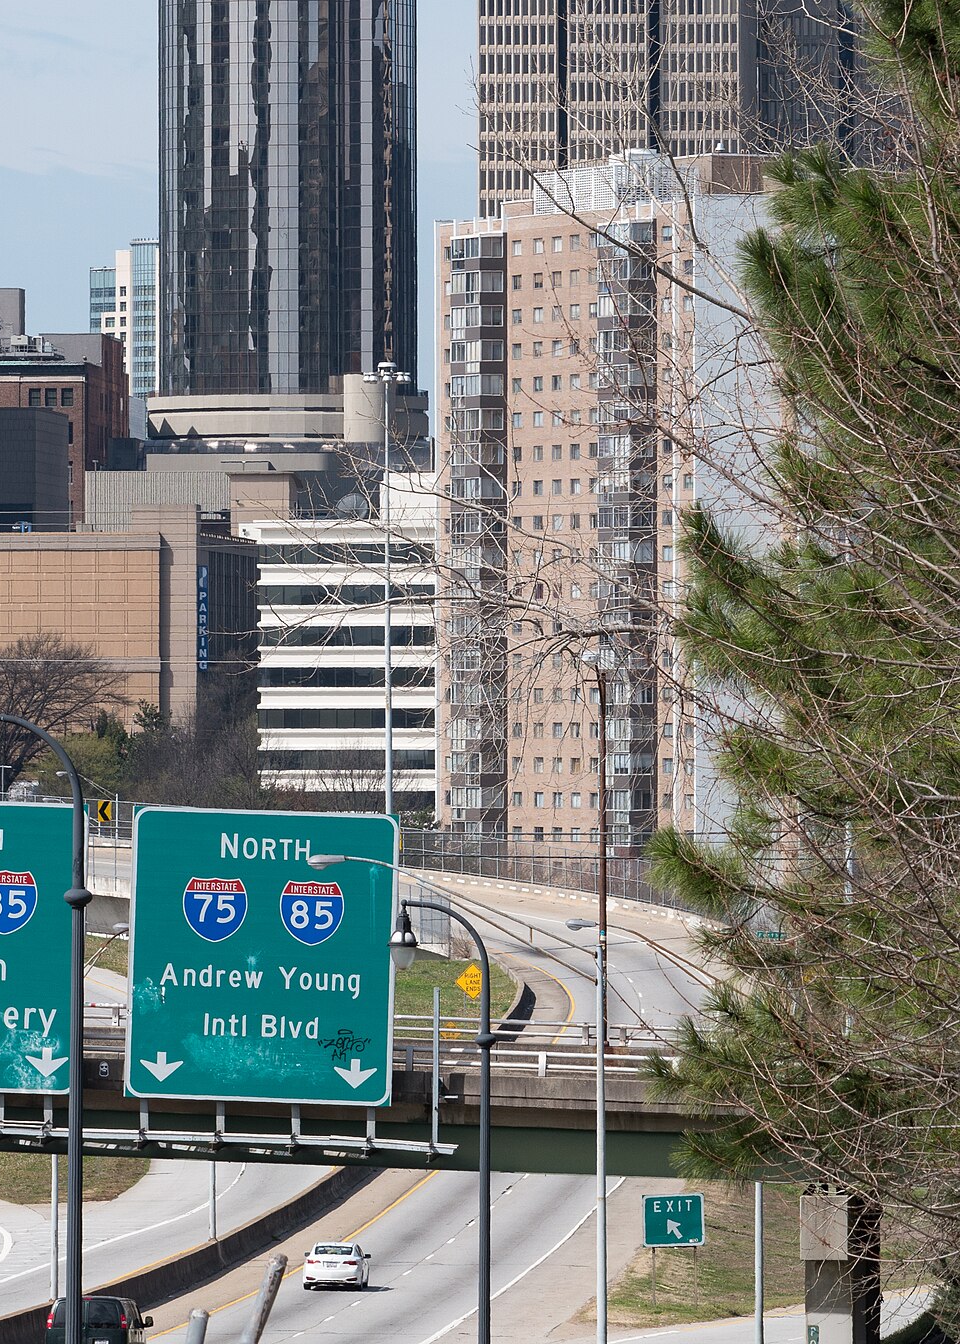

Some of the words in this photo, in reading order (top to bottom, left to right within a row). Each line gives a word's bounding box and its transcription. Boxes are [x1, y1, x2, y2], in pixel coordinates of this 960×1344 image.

[198, 591, 208, 670] PARKING
[220, 832, 311, 861] NORTH
[194, 881, 238, 892] INTERSTATE
[290, 884, 335, 895] INTERSTATE
[193, 893, 236, 924] 75
[290, 899, 334, 930] 85
[160, 962, 263, 990] Andrew
[279, 966, 361, 1000] Young
[203, 1012, 247, 1037] Intl
[261, 1014, 319, 1040] Blvd
[653, 1199, 693, 1213] EXIT
